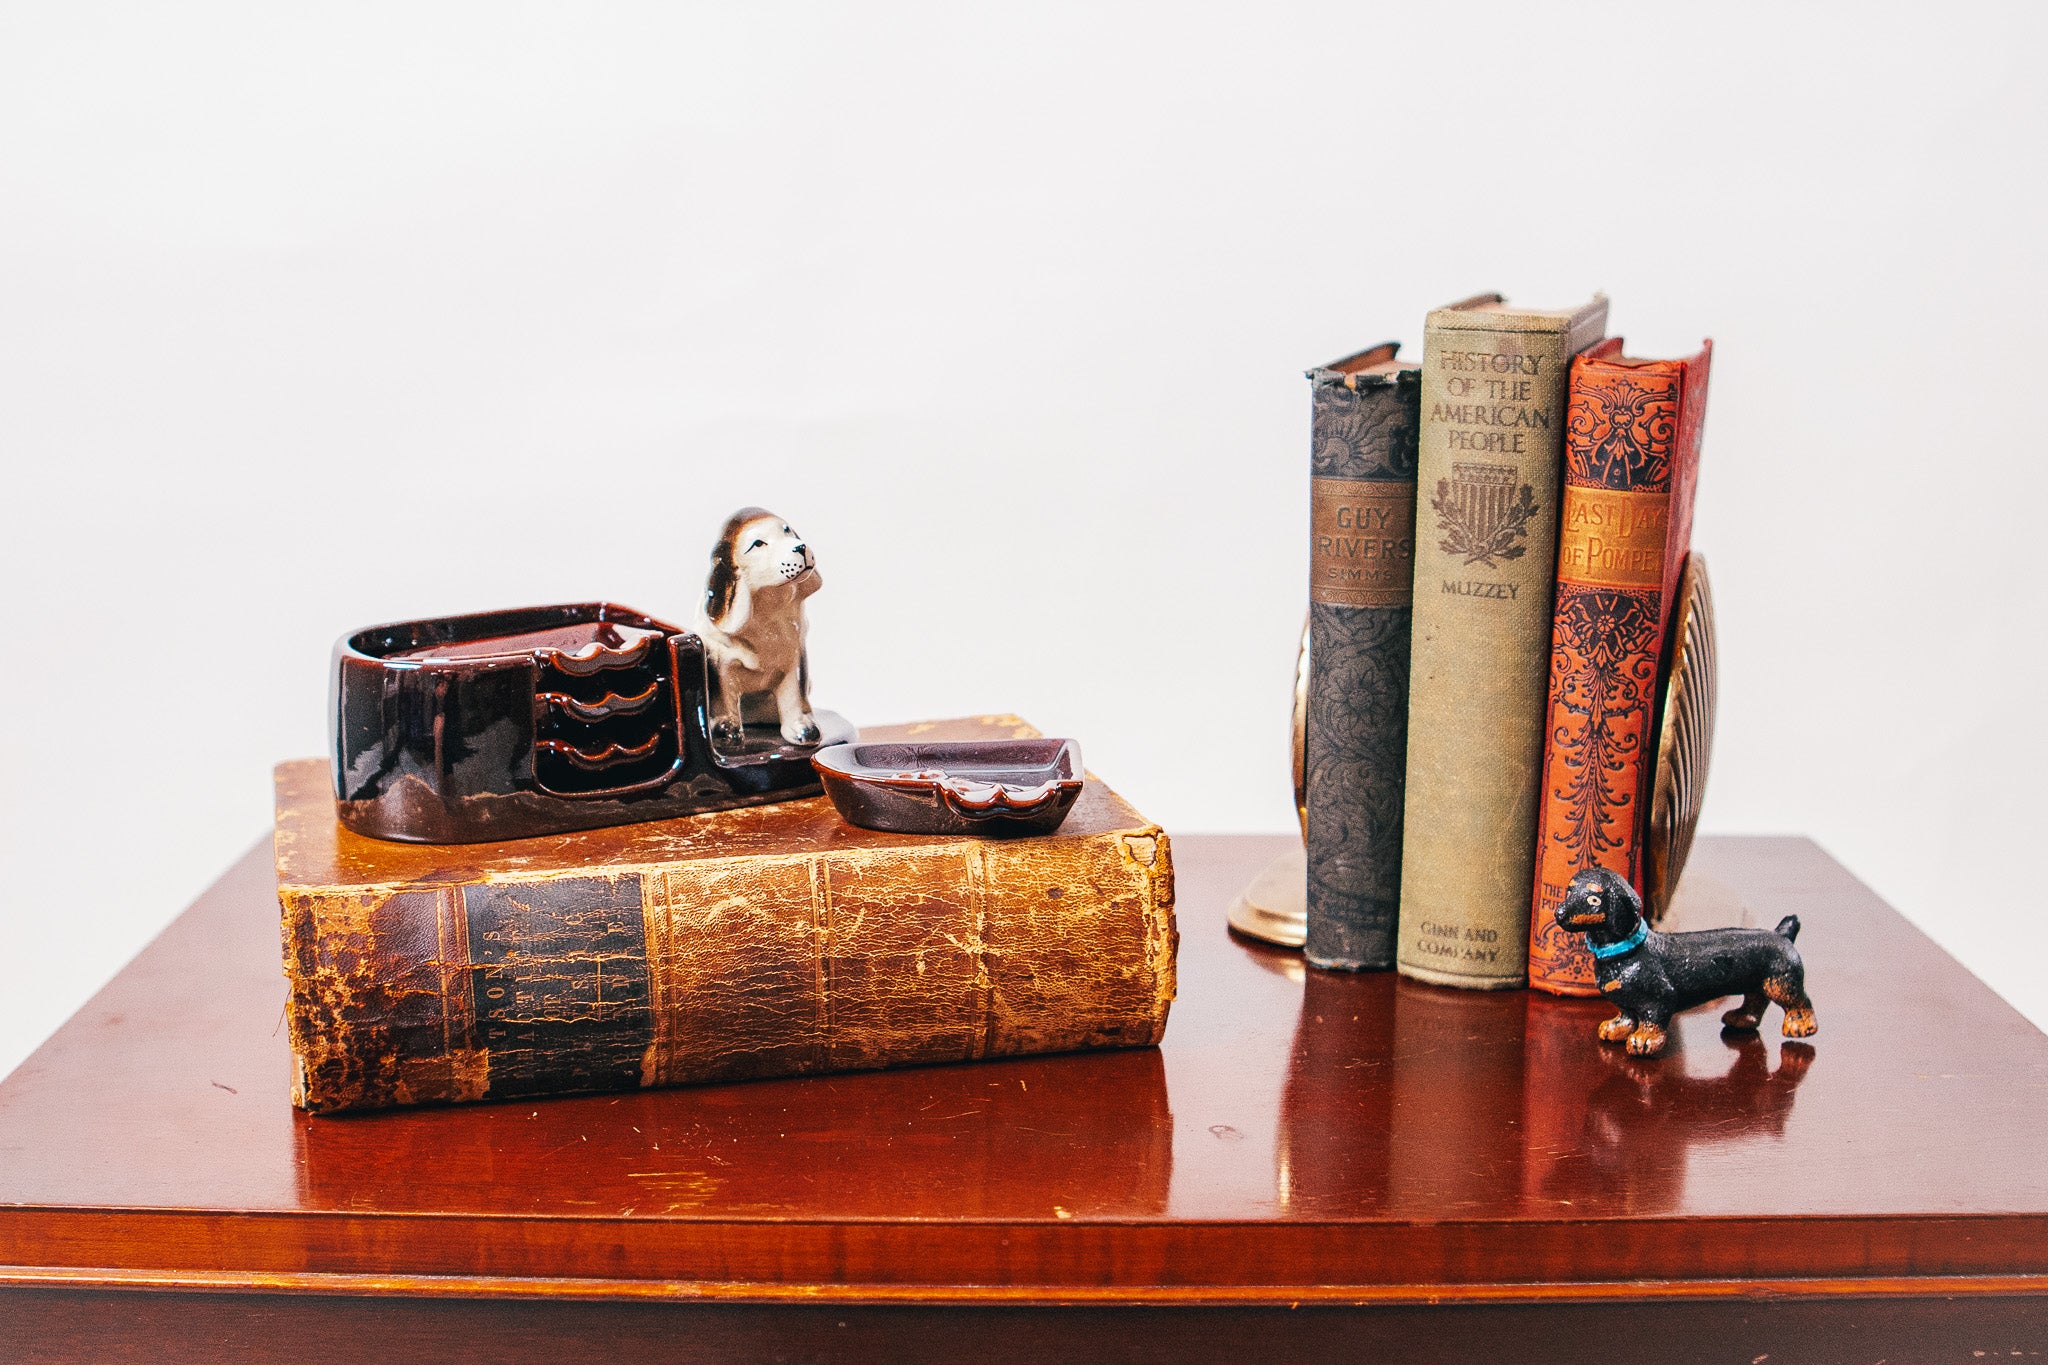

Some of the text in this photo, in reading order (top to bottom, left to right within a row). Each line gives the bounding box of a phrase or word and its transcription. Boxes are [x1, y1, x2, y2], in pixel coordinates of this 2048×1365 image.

[1440, 350, 1543, 375] HISTORY
[1446, 377, 1531, 401] OF THE
[1430, 403, 1549, 428] AMERICAN
[1448, 429, 1526, 454] PEOPLE
[1336, 506, 1392, 529] GUY
[1318, 535, 1411, 560] RIVERS
[1563, 546, 1584, 566] OF
[1328, 567, 1393, 581] SIMMS
[1441, 580, 1521, 600] MUZZEY
[1543, 883, 1563, 899] THE
[1464, 928, 1498, 942] AND
